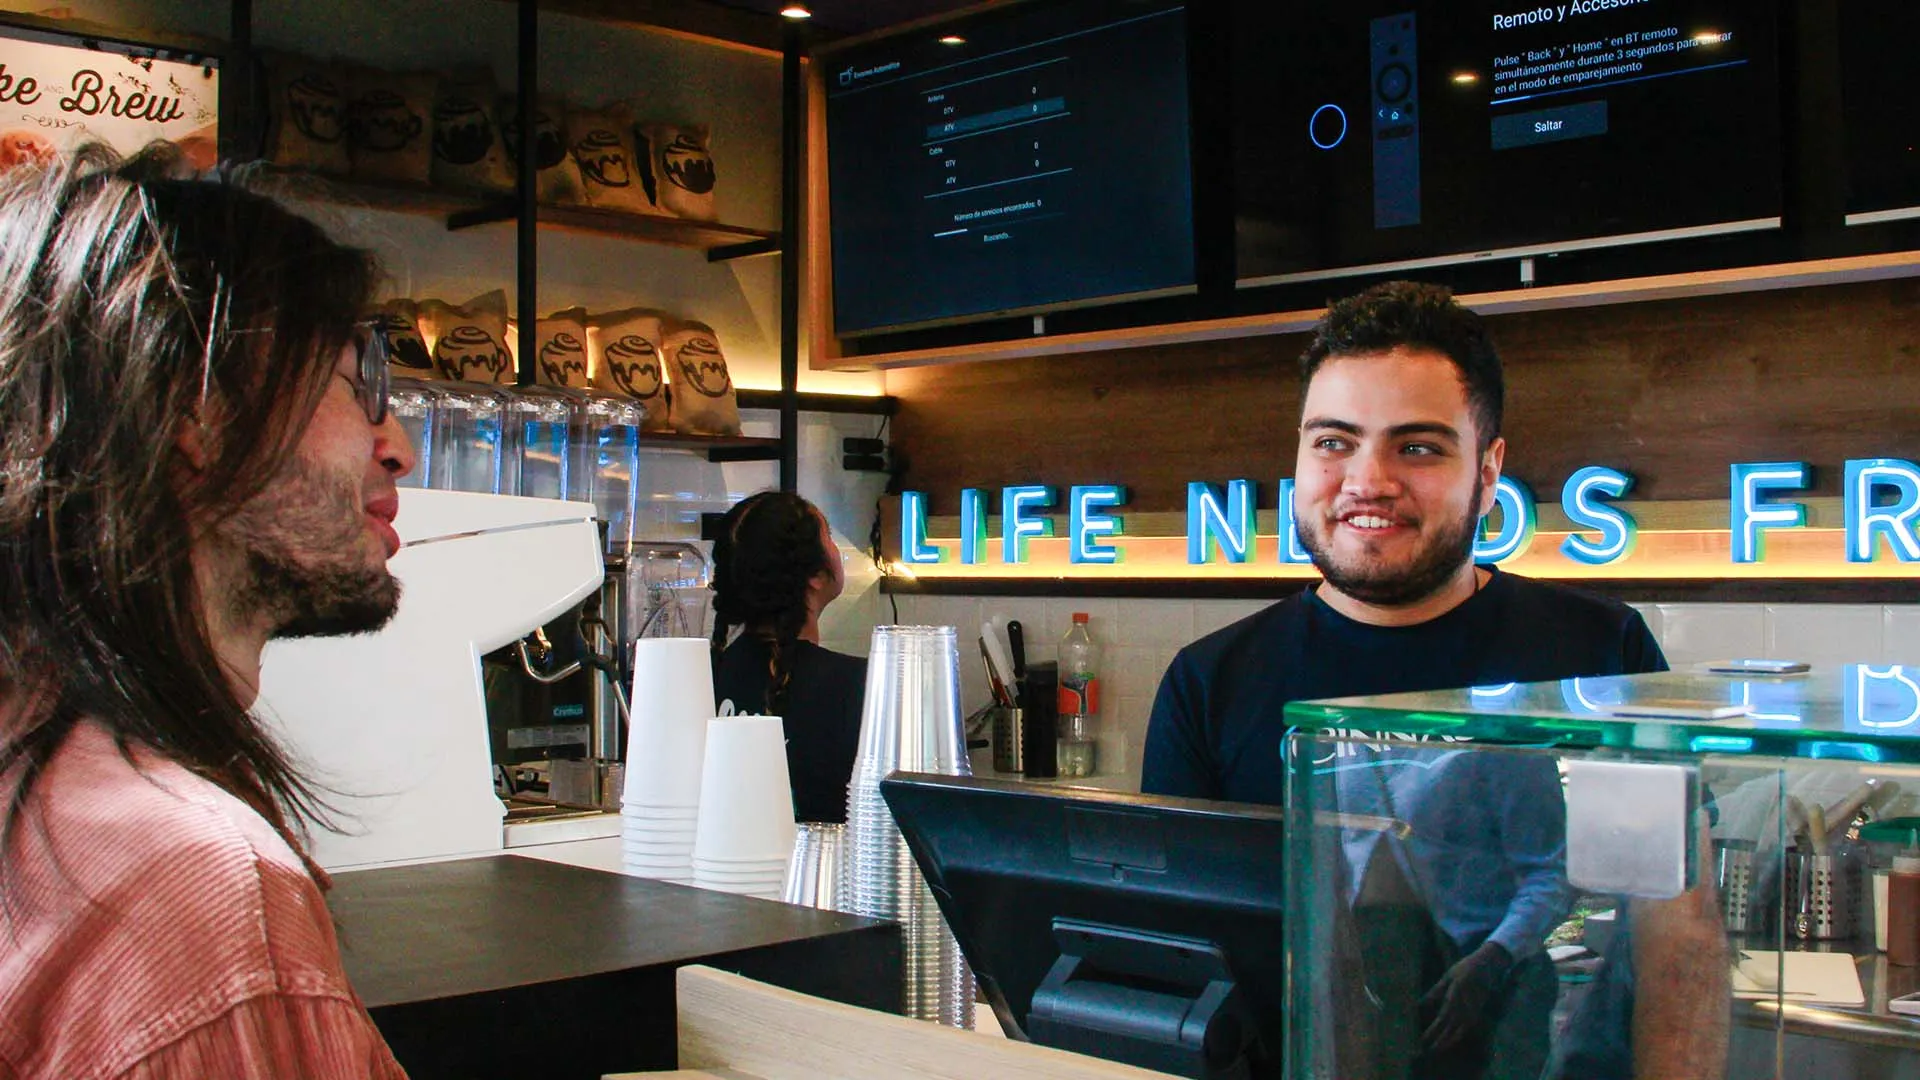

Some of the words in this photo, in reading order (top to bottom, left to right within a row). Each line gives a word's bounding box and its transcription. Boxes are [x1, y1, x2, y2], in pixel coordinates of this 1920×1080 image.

[1493, 7, 1553, 30] Remoto
[1556, 5, 1566, 22] y
[1494, 55, 1520, 68] Pulse
[1610, 37, 1623, 46] en
[1625, 31, 1639, 44] BT
[1641, 26, 1678, 40] remoto
[1577, 52, 1614, 66] durante
[1616, 49, 1623, 59] 3
[1625, 42, 1674, 58] segundos
[1676, 39, 1698, 52] para
[1494, 85, 1507, 94] en
[1508, 81, 1517, 92] el
[1519, 78, 1547, 90] modo
[1548, 74, 1561, 85] de
[1563, 61, 1643, 83] emparejamiento
[59, 69, 185, 123] Brew
[1534, 119, 1563, 133] Saltar
[902, 485, 1126, 564] LIFE
[1187, 465, 1637, 564] NDS
